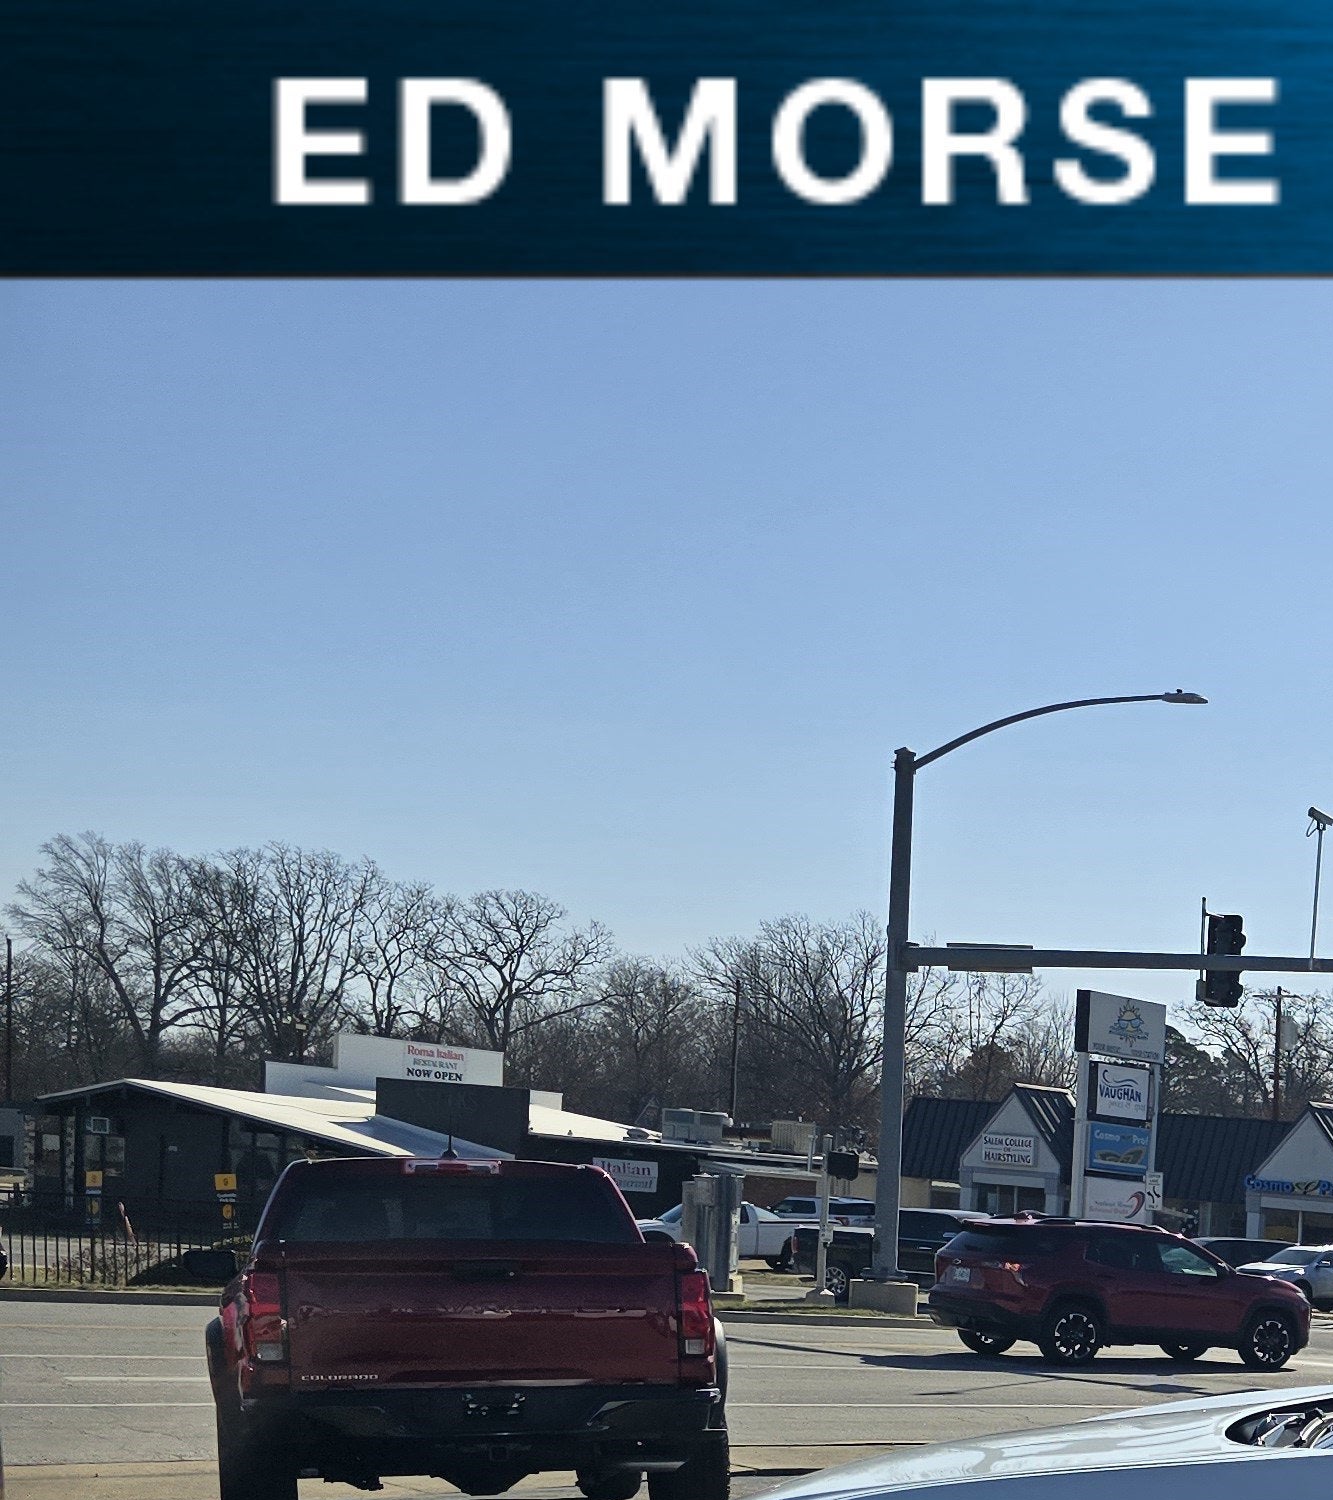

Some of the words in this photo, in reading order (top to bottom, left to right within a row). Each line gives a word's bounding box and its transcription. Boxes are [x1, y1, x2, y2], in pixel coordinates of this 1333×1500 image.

[407, 1044, 435, 1057] Roma
[406, 1067, 432, 1078] NOW
[434, 1071, 463, 1082] OPEN
[1099, 1084, 1142, 1102] VAUGHAN
[1094, 1129, 1121, 1142] Cosmo
[1131, 1134, 1149, 1145] Prof
[1245, 1173, 1294, 1193] Cosmo
